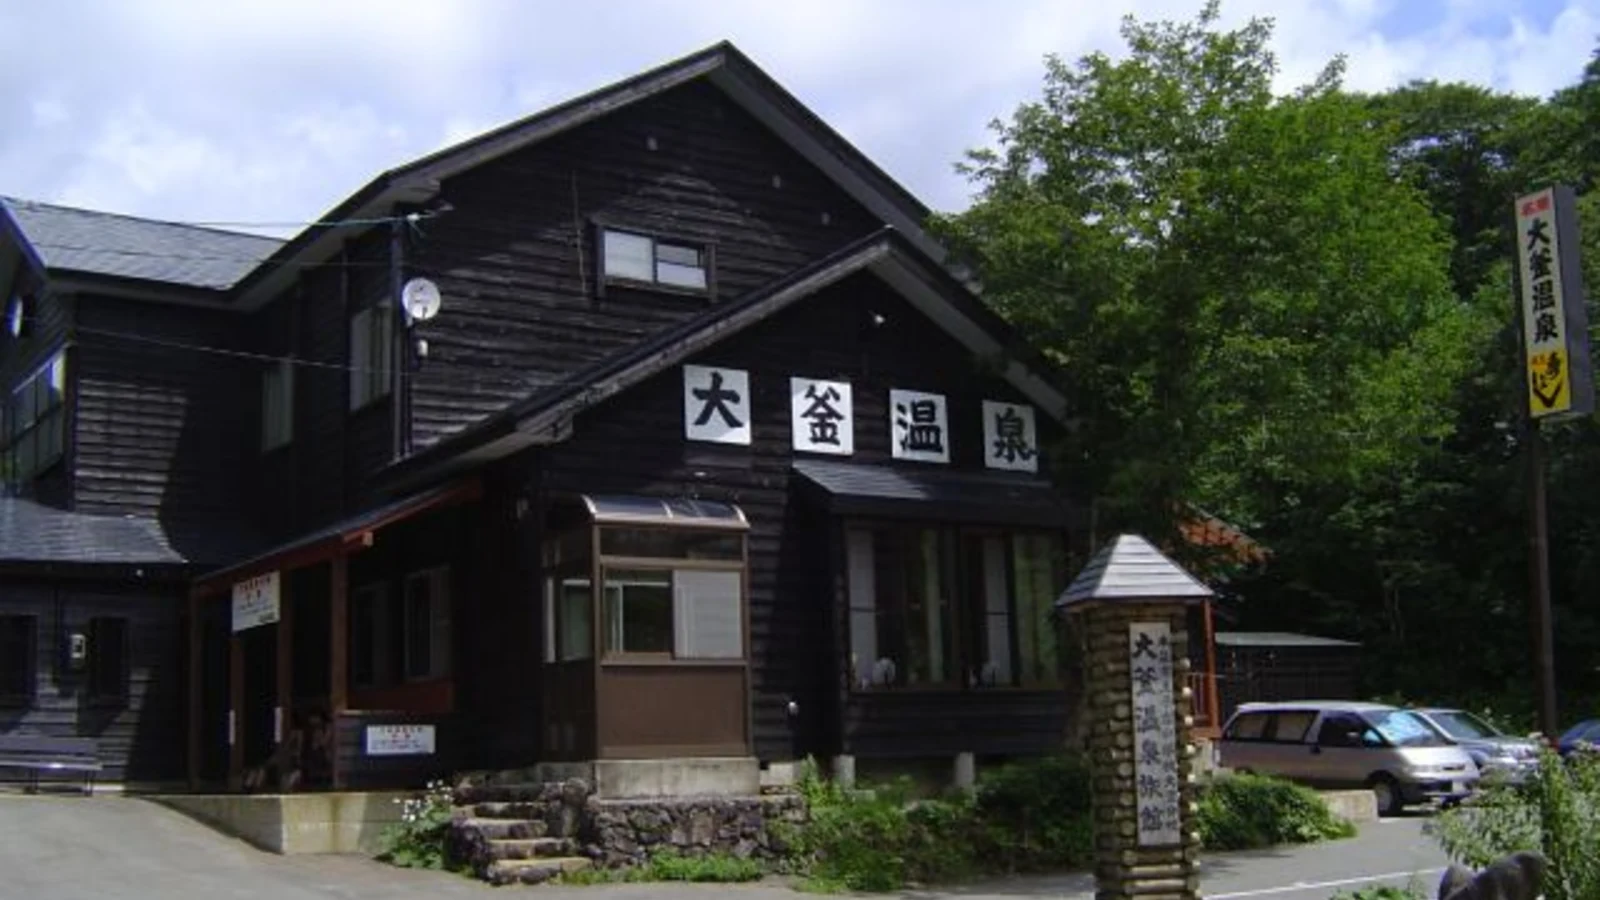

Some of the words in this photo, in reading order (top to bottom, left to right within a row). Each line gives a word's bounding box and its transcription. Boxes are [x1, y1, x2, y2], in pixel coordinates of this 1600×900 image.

[1526, 217, 1559, 344] 大釜温泉
[692, 371, 1037, 463] 大釜温泉
